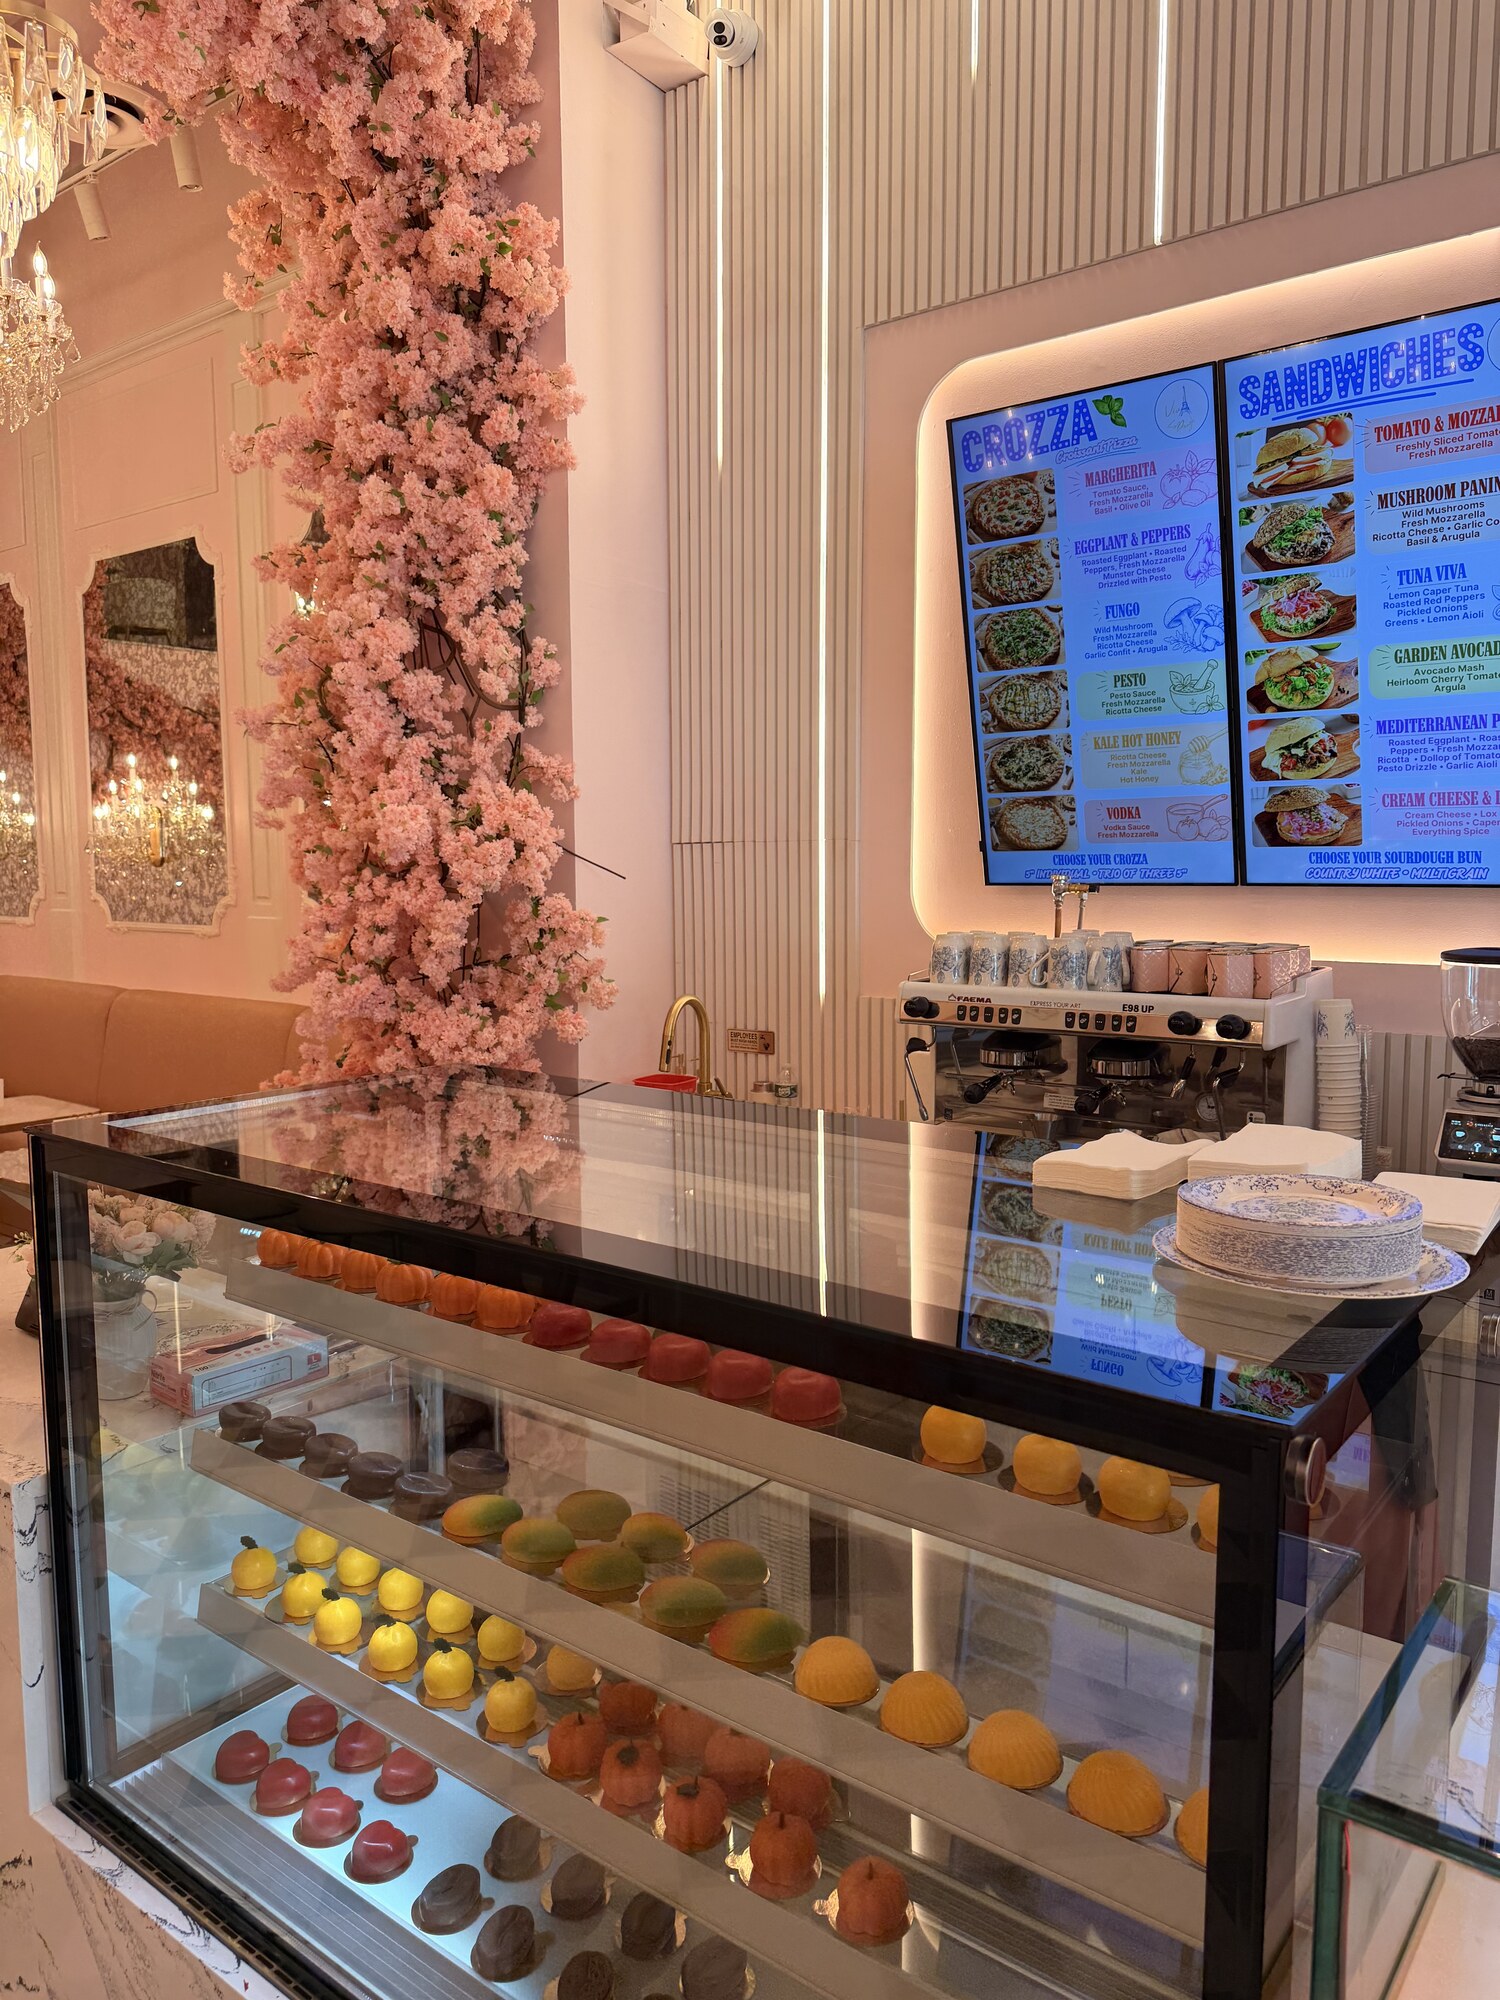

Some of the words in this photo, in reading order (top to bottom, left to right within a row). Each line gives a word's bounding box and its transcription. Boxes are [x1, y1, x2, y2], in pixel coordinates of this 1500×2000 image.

[1239, 323, 1485, 420] SANDWICHES
[961, 398, 1098, 473] CROZZA
[1374, 418, 1431, 443] TOMATO
[1435, 415, 1444, 433] &
[1055, 441, 1105, 465] Croissant
[1105, 436, 1138, 452] Pizza
[1396, 439, 1432, 454] Freshly
[1434, 434, 1466, 447] Sliced
[1409, 448, 1437, 460] Fresh
[1439, 439, 1493, 456] Mozzarella
[1085, 461, 1157, 487] MARGHERITA
[1089, 498, 1111, 507] Fresh
[1112, 491, 1154, 504] Mozzarella
[1093, 488, 1121, 498] Tomato
[1378, 483, 1458, 509] MUSHROOM
[1095, 506, 1113, 515] Basil
[1120, 502, 1139, 511] Olive
[1141, 500, 1151, 508] Oil
[1402, 509, 1423, 519] Wild
[1425, 500, 1485, 516] Mushrooms
[1401, 518, 1428, 529] Fresh
[1430, 510, 1486, 525] Mozzarella
[1373, 530, 1406, 542] Ricotta
[1408, 525, 1445, 537] Cheese
[1454, 520, 1484, 531] Garlic
[1407, 536, 1430, 546] Basil
[1432, 535, 1439, 543] &
[1440, 530, 1480, 543] Arugula
[1074, 534, 1128, 555] EGGPLANT
[1131, 532, 1139, 547] &
[1141, 525, 1191, 546] PEPPERS
[1082, 556, 1112, 567] Roasted
[1114, 551, 1148, 563] Eggplant
[1155, 546, 1187, 556] Roasted
[1084, 564, 1118, 575] Peppers,
[1119, 561, 1141, 570] Fresh
[1143, 555, 1185, 566] Mozzarella
[1103, 570, 1135, 580] Munster
[1137, 566, 1166, 576] Cheese
[1397, 566, 1432, 586] TUNA
[1435, 562, 1467, 582] VIVA
[1098, 579, 1130, 589] Drizzled
[1131, 577, 1147, 585] with
[1148, 573, 1172, 583] Pesto
[1389, 590, 1420, 600] Lemon
[1423, 586, 1454, 598] Caper
[1456, 583, 1479, 593] Tuna
[1384, 599, 1422, 610] Roasted
[1424, 597, 1442, 606] Red
[1443, 592, 1485, 605] Peppers
[1105, 602, 1140, 619] FUNGO
[1398, 607, 1427, 617] Pickled
[1428, 603, 1468, 614] Onions
[1385, 617, 1419, 627] Greens
[1427, 613, 1460, 623] Lemon
[1462, 610, 1484, 620] Aioli
[1113, 622, 1153, 632] Mushroom
[1093, 634, 1114, 642] Fresh
[1115, 629, 1157, 640] Mozzarella
[1097, 641, 1123, 650] Ricotta
[1125, 638, 1154, 647] Cheese
[1085, 651, 1106, 659] Garlic
[1107, 648, 1131, 657] Confit
[1138, 645, 1168, 655] Arugula
[1394, 645, 1448, 664] GARDEN
[1414, 666, 1456, 676] Avocado
[1458, 663, 1485, 673] Mash
[1113, 673, 1146, 688] PESTO
[1387, 677, 1429, 687] Heirloom
[1431, 674, 1464, 685] Cherry
[1110, 692, 1132, 700] Pesto
[1133, 690, 1156, 698] Sauce
[1435, 683, 1466, 694] Argula
[1124, 697, 1166, 706] Mozzarella
[1133, 705, 1162, 713] Cheese
[1376, 714, 1488, 735] MEDITERRANEAN
[1093, 736, 1119, 750] KALE
[1122, 734, 1145, 748] HOT
[1147, 731, 1182, 746] HONEY
[1389, 738, 1426, 747] Roasted
[1428, 735, 1470, 746] Eggplant
[1137, 752, 1167, 760] Cheese
[1391, 747, 1429, 756] Peppers
[1437, 745, 1462, 753] Fresh
[1130, 759, 1171, 768] Mozzarella
[1378, 756, 1410, 764] Ricotta
[1420, 754, 1450, 764] Dollop
[1452, 753, 1462, 761] of
[1378, 764, 1403, 773] Pesto
[1405, 763, 1437, 772] Drizzle
[1446, 761, 1475, 770] Garlic
[1477, 760, 1498, 769] Aioli
[1133, 776, 1159, 784] Honey
[1382, 793, 1426, 807] CREAM
[1429, 791, 1479, 806] CHEESE
[1482, 791, 1492, 805] &
[1107, 807, 1141, 820] VODKA
[1480, 810, 1497, 818] Lox
[1412, 828, 1462, 837] Everything
[1463, 828, 1490, 836] Spice
[1053, 855, 1087, 865] CHOOSE
[1088, 854, 1112, 865] YOUR
[1113, 854, 1148, 865] CROZZA
[1309, 852, 1350, 864] CHOOSE
[1352, 852, 1382, 864] YOUR
[1384, 852, 1454, 863] SOURDOUGH
[1458, 851, 1482, 863] BUN
[1095, 869, 1122, 879] TRIO
[1123, 869, 1137, 878] OF
[1139, 868, 1175, 878] THREE
[1305, 868, 1359, 879] COUNTRY
[1360, 868, 1401, 879] WHITE
[1409, 868, 1489, 880] MULTIGRAIN
[956, 995, 992, 1004] FAEMA
[1122, 1003, 1140, 1013] E98
[1141, 1005, 1155, 1014] UP
[730, 1032, 758, 1040] EMPLOYEES
